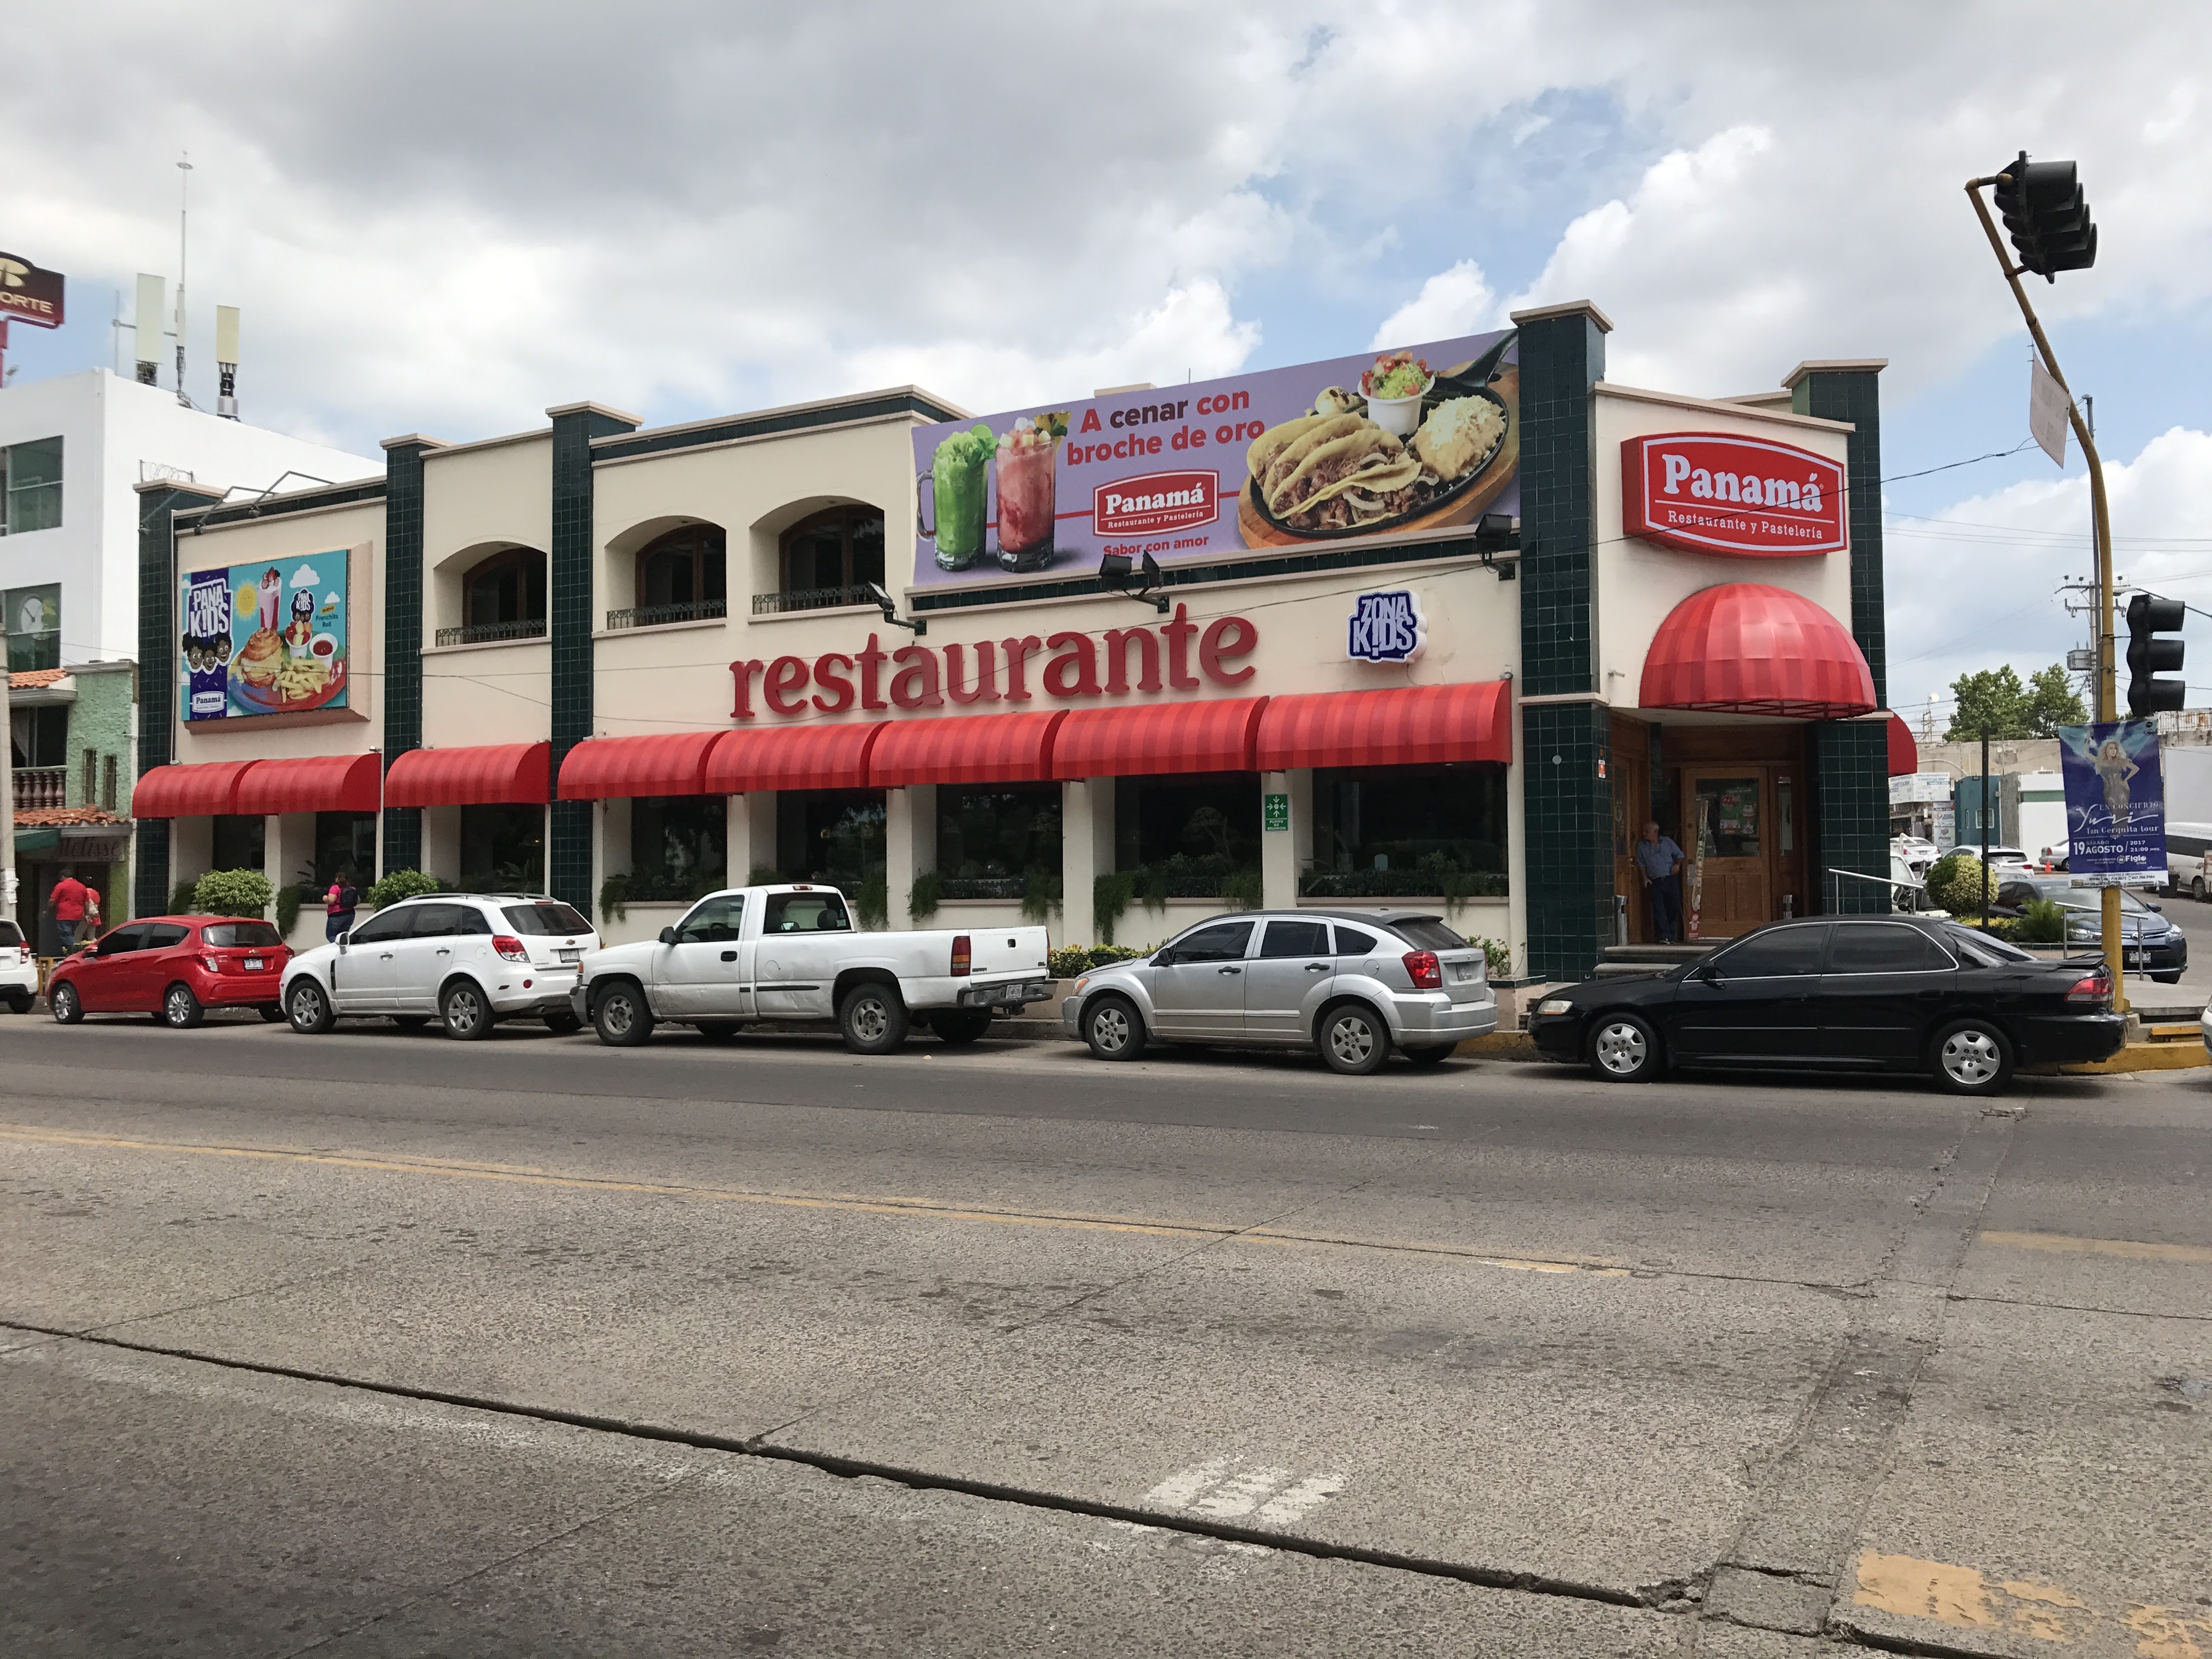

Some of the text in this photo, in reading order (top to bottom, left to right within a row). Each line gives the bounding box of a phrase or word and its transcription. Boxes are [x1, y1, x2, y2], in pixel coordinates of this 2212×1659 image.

[1080, 390, 1250, 434] A cenar con
[1067, 420, 1265, 466] broche de oro
[1662, 453, 1822, 513] Panamá
[1105, 482, 1204, 515] Panamá
[1108, 517, 1154, 529] Restaurante
[1164, 511, 1204, 521] Pastelería
[1668, 510, 1822, 539] Restaurante y Pastelería
[1103, 536, 1209, 556] Sabor con amor
[193, 585, 224, 611] PANA
[1361, 596, 1409, 623] ZONA
[730, 602, 1258, 719] restaurante
[196, 695, 221, 704] Panamá
[2074, 804, 2159, 832] Yuri
[2101, 826, 2138, 836] Cerquita
[2073, 841, 2124, 855] 19 AGOSTO
